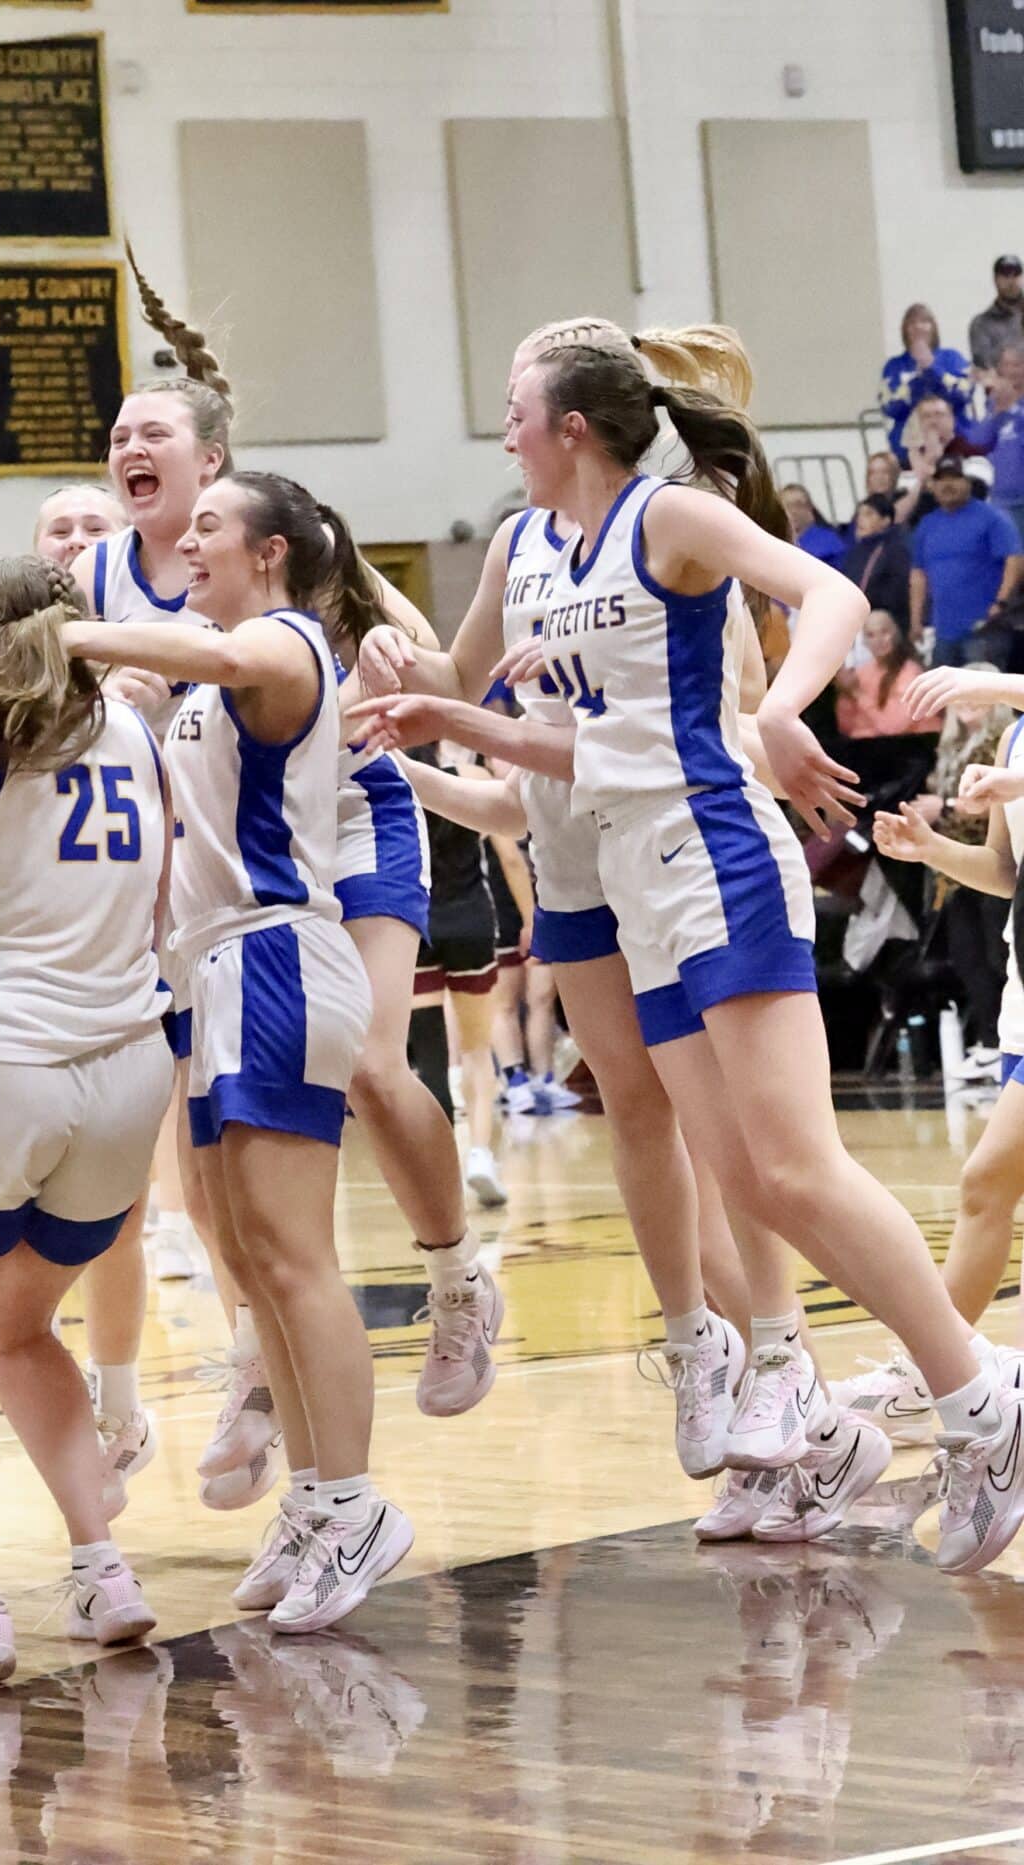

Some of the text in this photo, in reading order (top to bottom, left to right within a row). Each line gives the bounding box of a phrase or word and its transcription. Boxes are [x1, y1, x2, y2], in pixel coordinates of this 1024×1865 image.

[7, 48, 96, 75] COUNTRY
[34, 276, 113, 301] COUNTRY
[51, 304, 106, 328] PLACE
[54, 763, 143, 864] 25
